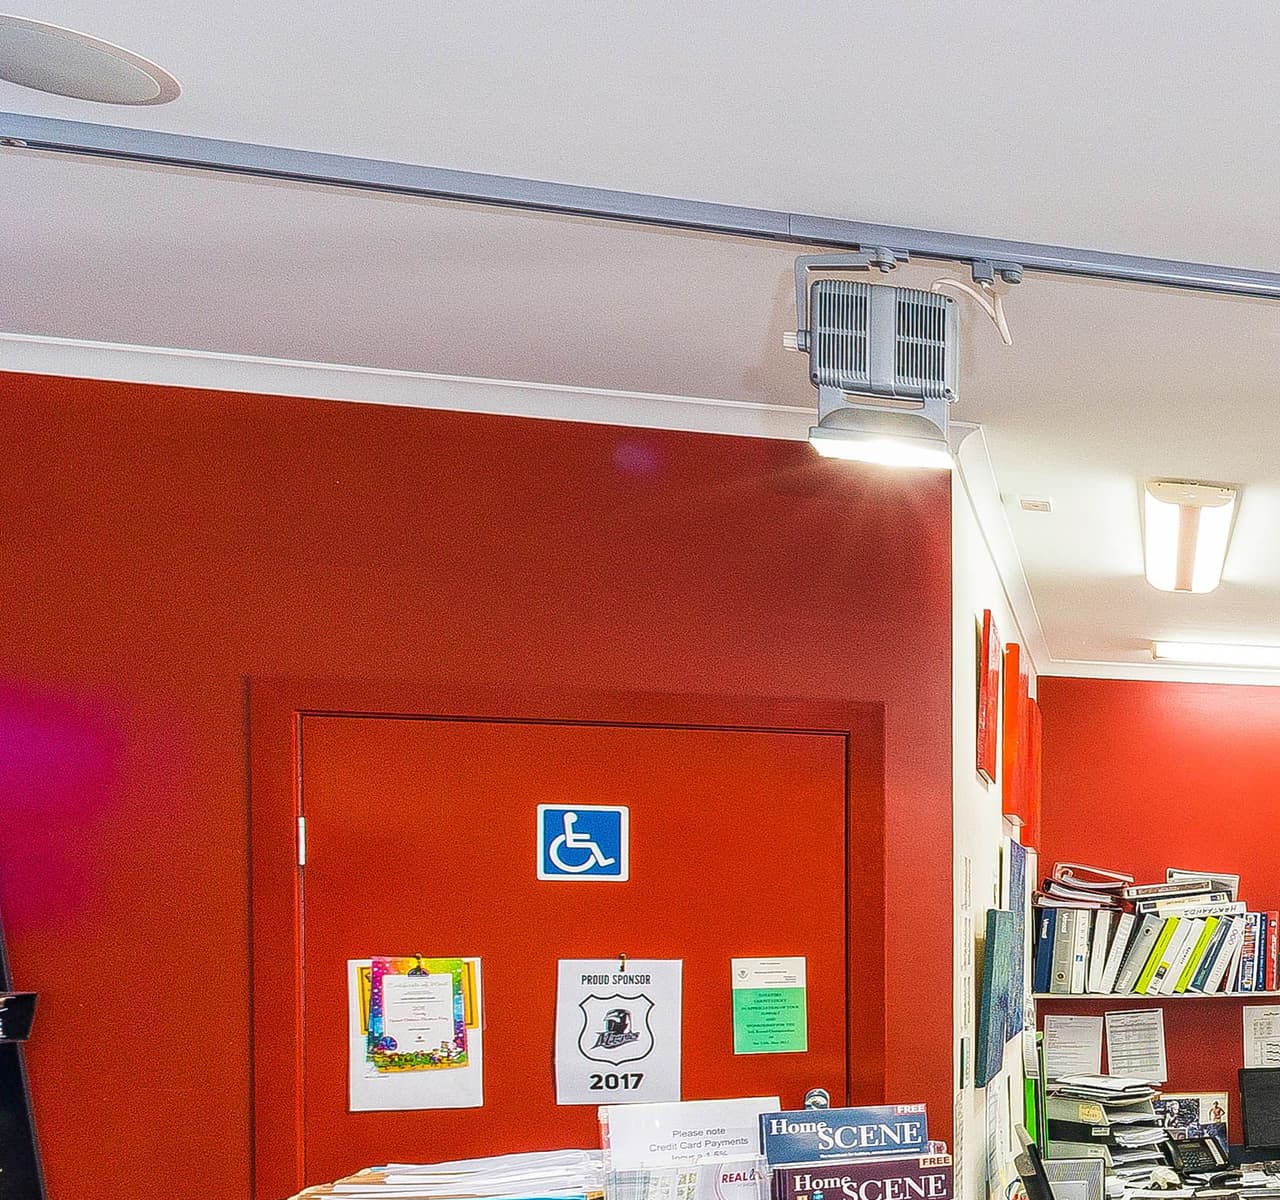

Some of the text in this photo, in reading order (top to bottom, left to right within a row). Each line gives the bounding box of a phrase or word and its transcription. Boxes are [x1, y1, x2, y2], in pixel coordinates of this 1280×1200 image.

[581, 974, 651, 985] PROUD SPONSOR
[589, 1073, 644, 1090] 2017
[897, 1104, 925, 1113] FREE
[673, 1128, 726, 1138] Please note
[770, 1119, 827, 1136] Home
[818, 1122, 922, 1150] SCENE
[649, 1137, 749, 1152] Credit Card Payments
[922, 1156, 950, 1166] FREE
[722, 1172, 748, 1184] REAL
[793, 1175, 850, 1192] Home
